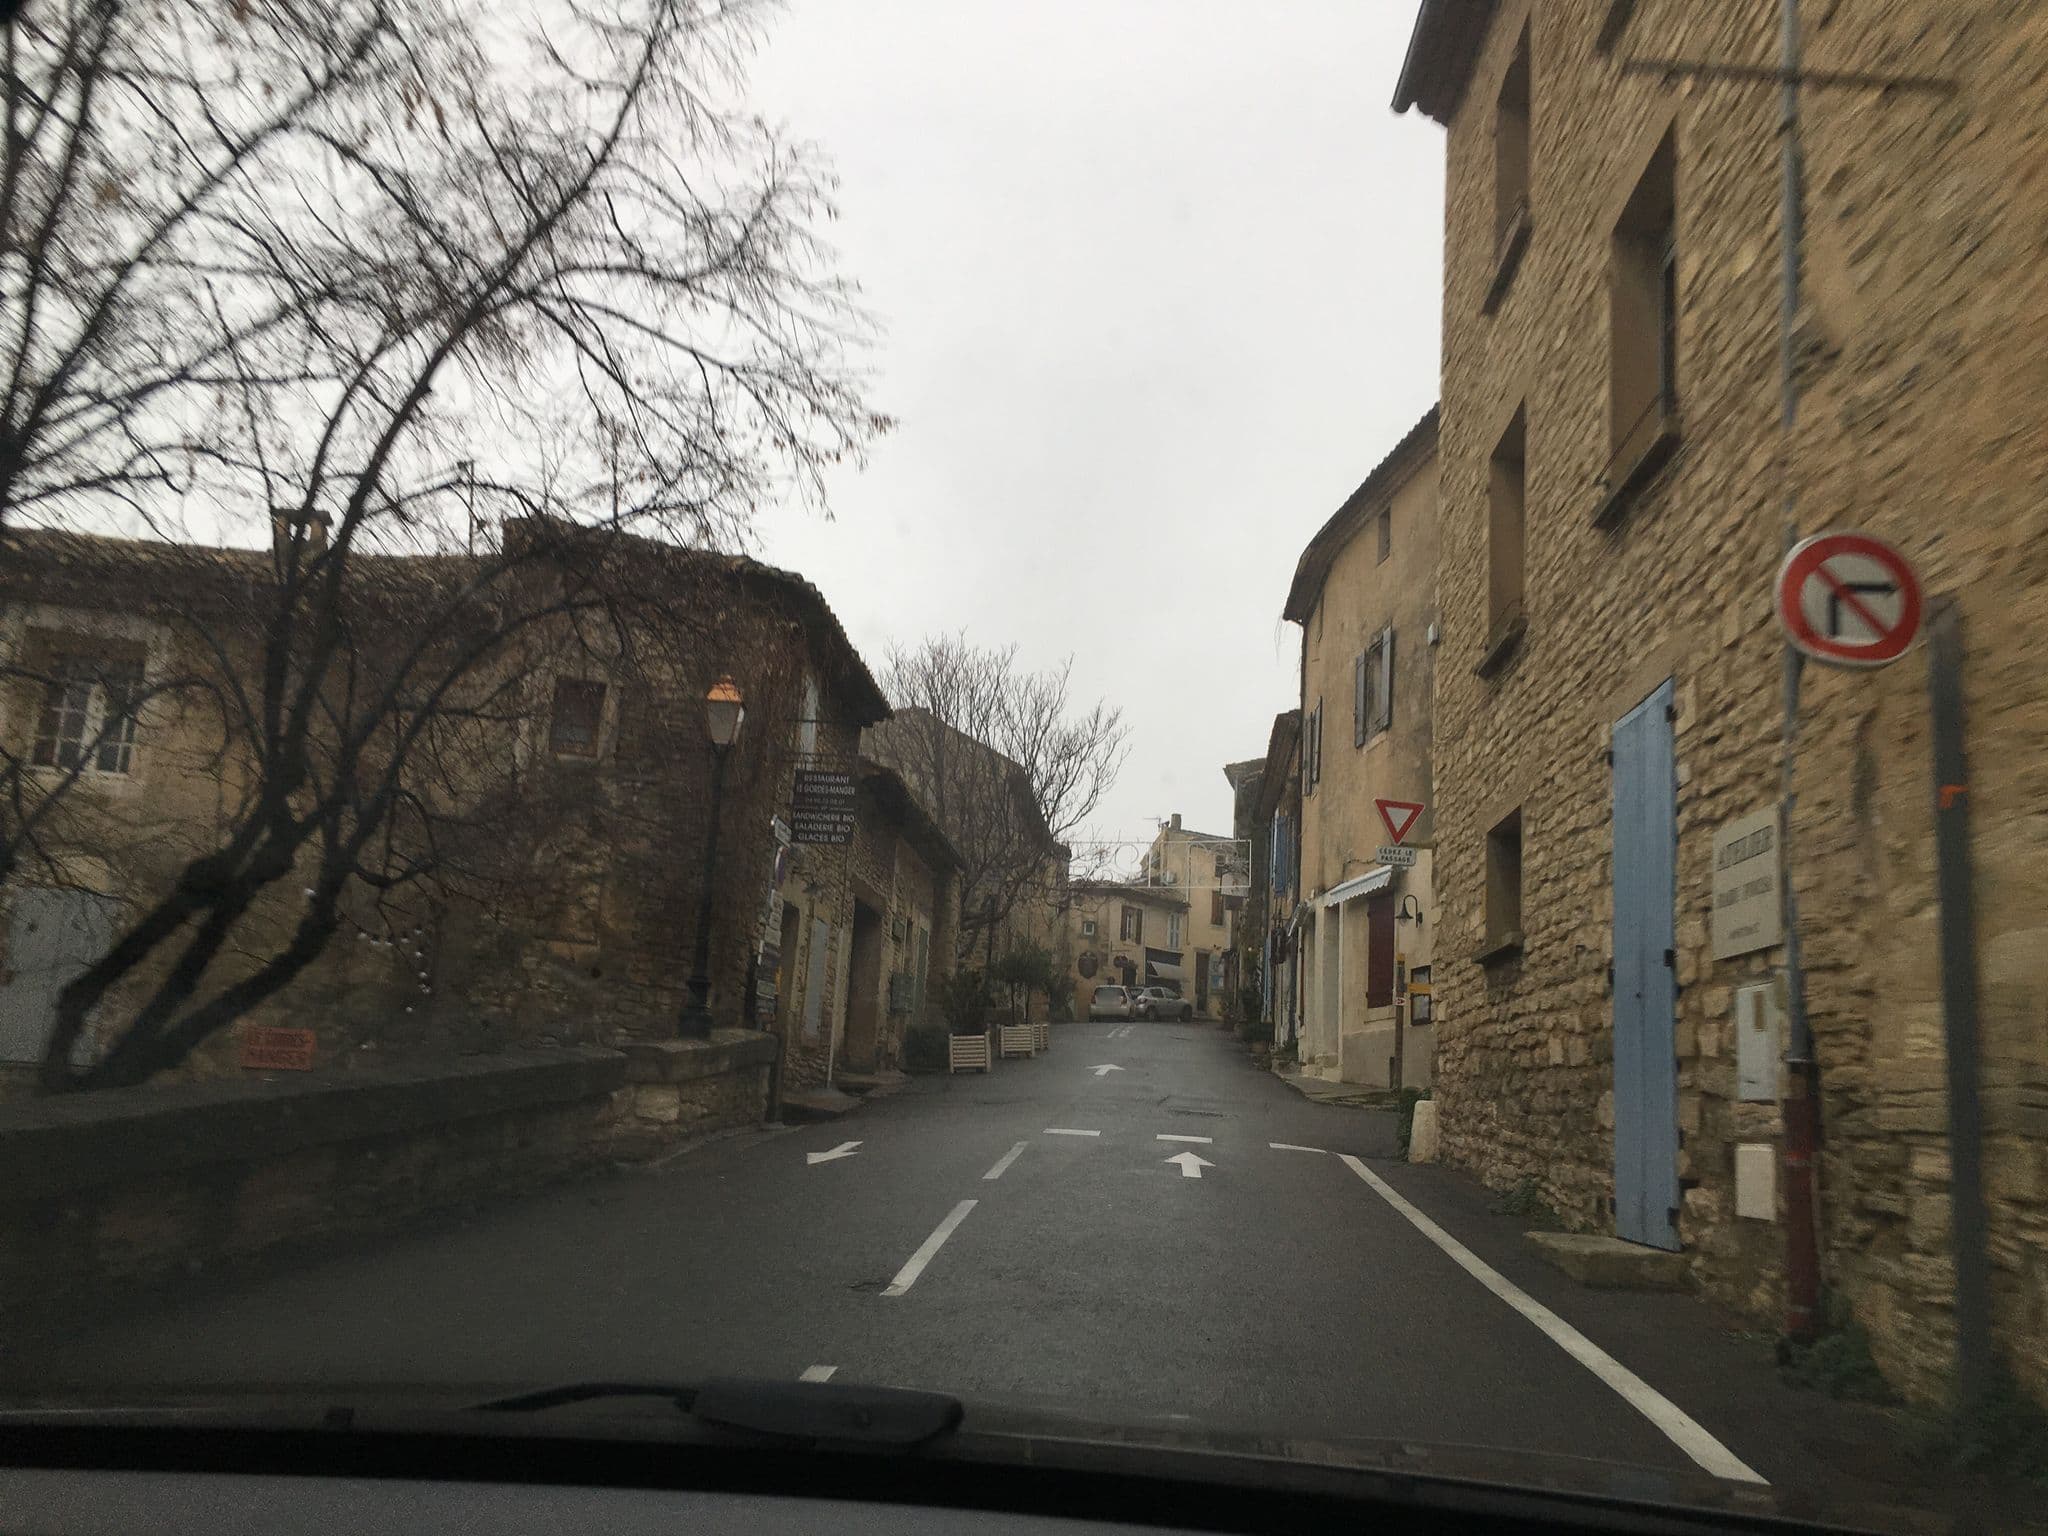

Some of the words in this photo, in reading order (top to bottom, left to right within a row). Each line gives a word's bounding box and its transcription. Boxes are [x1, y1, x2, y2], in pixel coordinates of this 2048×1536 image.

[804, 775, 849, 784] RESTAURANT
[842, 814, 855, 822] BIO
[837, 824, 850, 833] BIO
[798, 832, 829, 842] GLACES
[831, 834, 845, 843] BIO
[1381, 855, 1411, 863] PASSAGE
